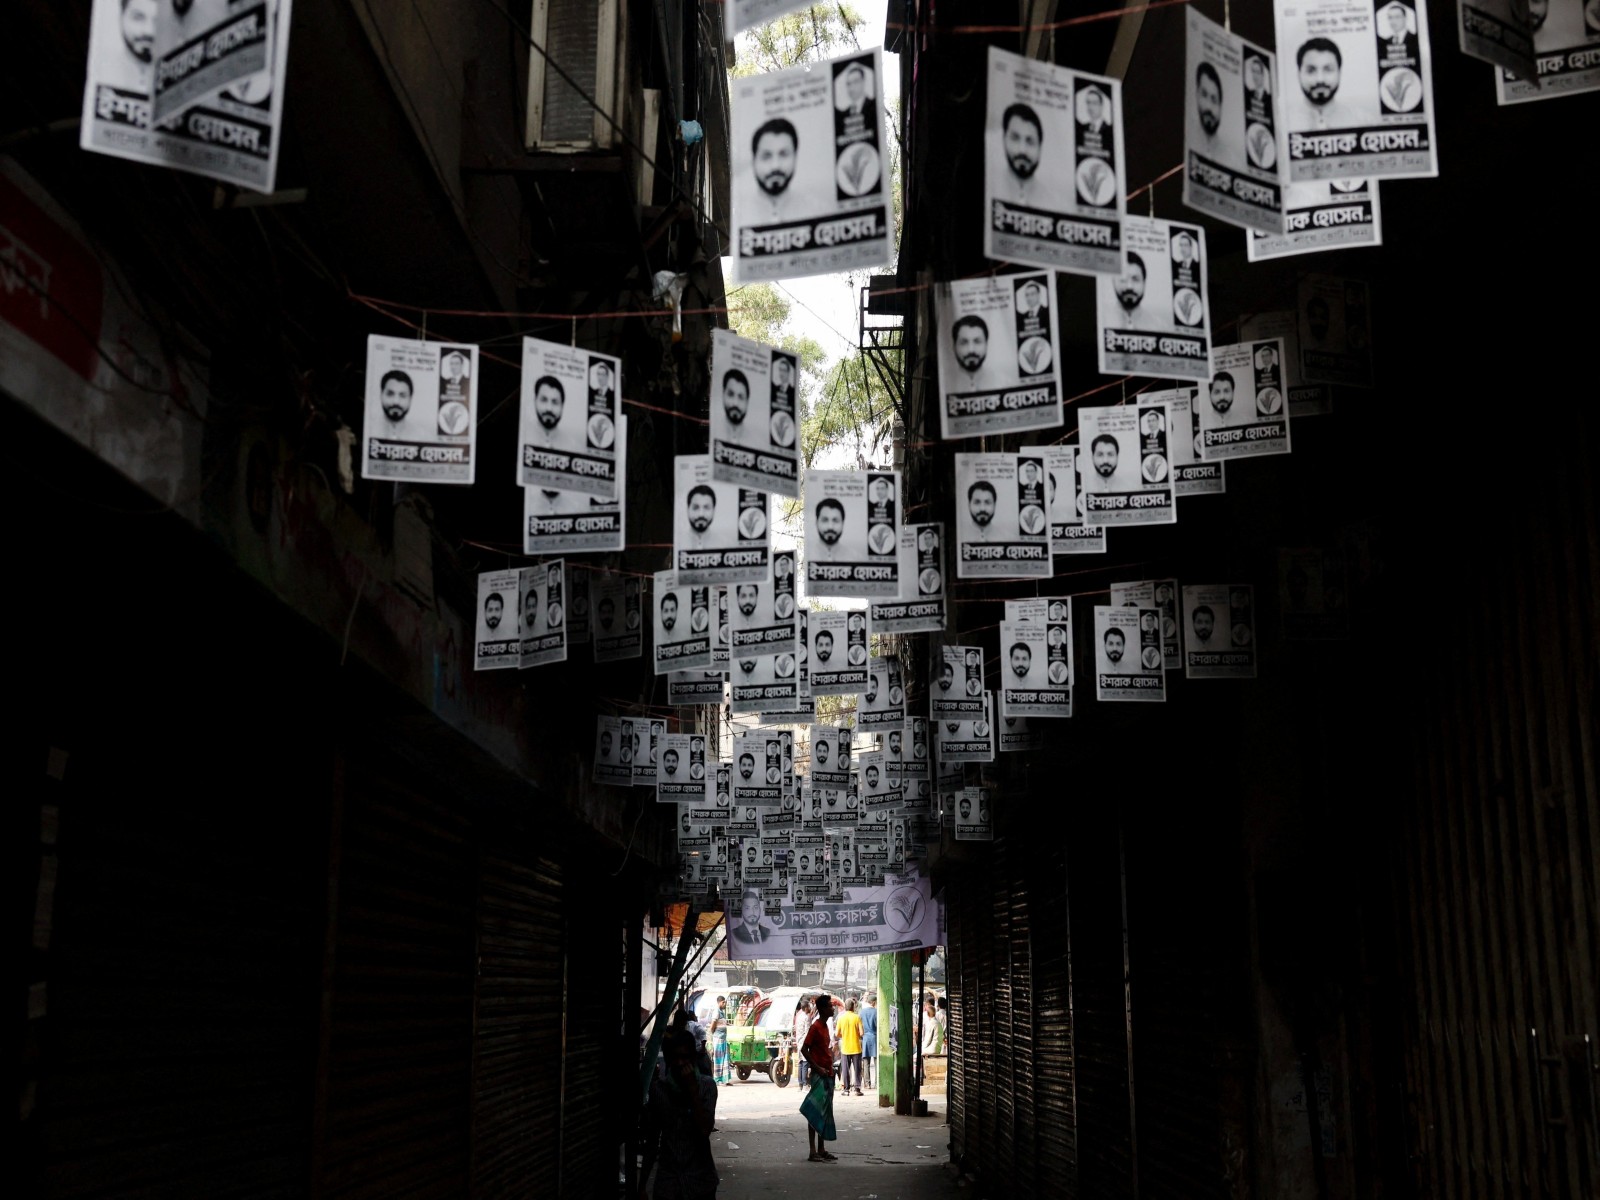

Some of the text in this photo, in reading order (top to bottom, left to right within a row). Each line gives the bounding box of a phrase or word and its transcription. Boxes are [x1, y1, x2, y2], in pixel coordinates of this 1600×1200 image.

[189, 113, 260, 152] হোসেন
[1291, 129, 1419, 158] ইশরাক হোসেন
[994, 200, 1053, 236] ইশরাক
[1056, 220, 1112, 246] হোসেন
[1313, 205, 1364, 227] হোসেন
[740, 215, 877, 256] ইশরাক হোসেন
[1105, 330, 1201, 357] ইশরাক হোসেন
[948, 388, 1049, 416] ইশরাক হোসেন
[1204, 425, 1280, 446] ইশরাক হোসেন
[370, 440, 464, 463] ইশরাক হোসেন
[524, 446, 610, 477] ইশরাক হোসেন
[715, 443, 792, 476] ইশরাক হোসেন
[1183, 465, 1215, 479] হোসেন
[1087, 494, 1165, 511] ইশরাক হোসেন
[530, 516, 613, 535] ইশরাক হোসেন
[1065, 526, 1095, 538] হোসেন
[679, 550, 762, 570] ইশরাক হোসেন
[962, 543, 1042, 560] ইশরাক হোসেন
[808, 563, 892, 581] ইশরাক হোসেন
[872, 602, 938, 619] ইশরাক হোসেন
[1100, 674, 1159, 687] ইশরাক হোসেন
[1006, 691, 1066, 704] ইশরাক হোসেন
